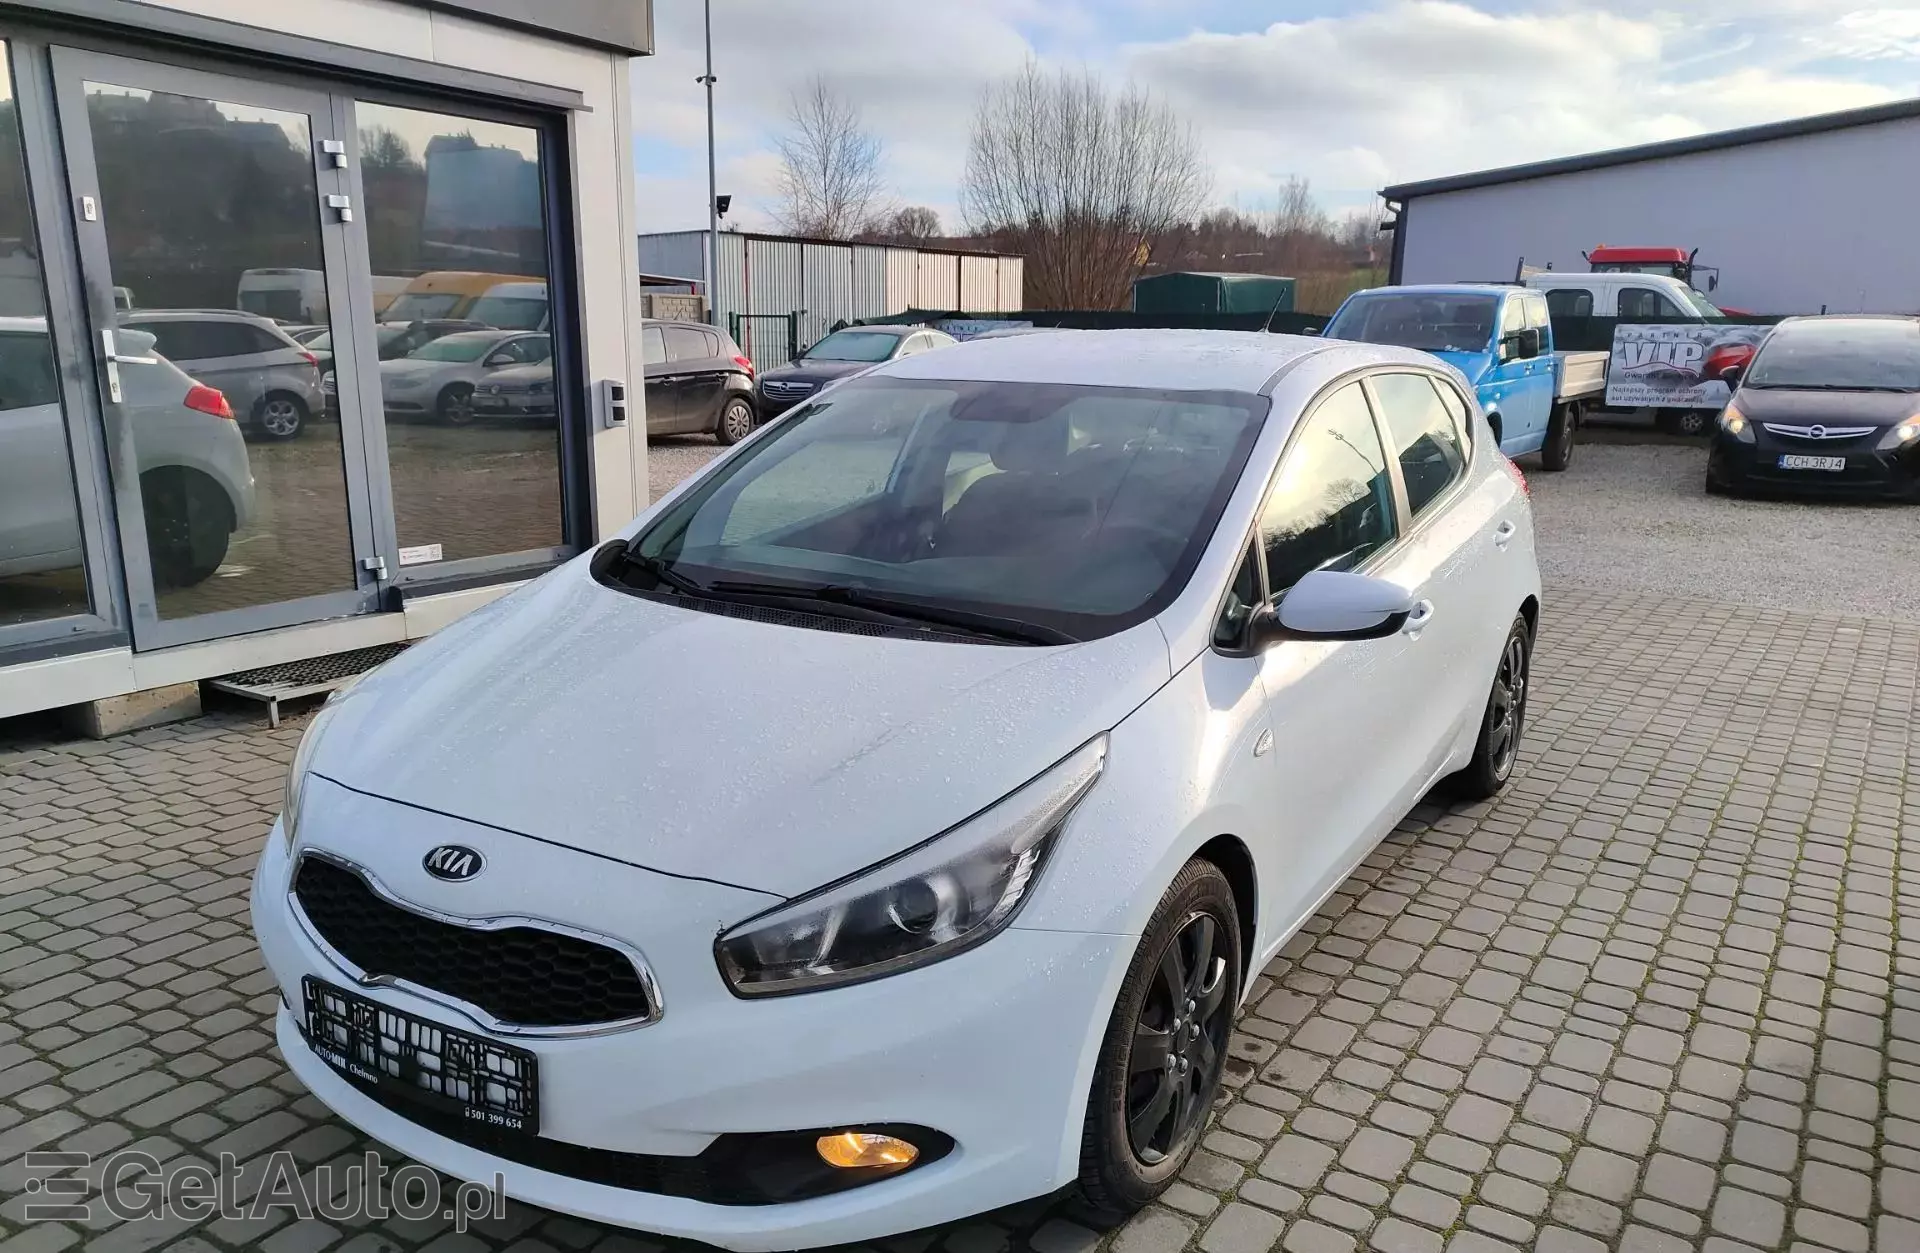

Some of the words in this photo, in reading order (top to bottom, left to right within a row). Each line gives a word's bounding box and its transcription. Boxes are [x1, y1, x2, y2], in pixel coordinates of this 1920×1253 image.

[1623, 341, 1705, 369] VIP
[1786, 456, 1809, 467] CCH
[427, 847, 474, 876] KIA
[471, 1109, 485, 1121] 501
[488, 1113, 504, 1125] 399
[506, 1117, 522, 1129] 654
